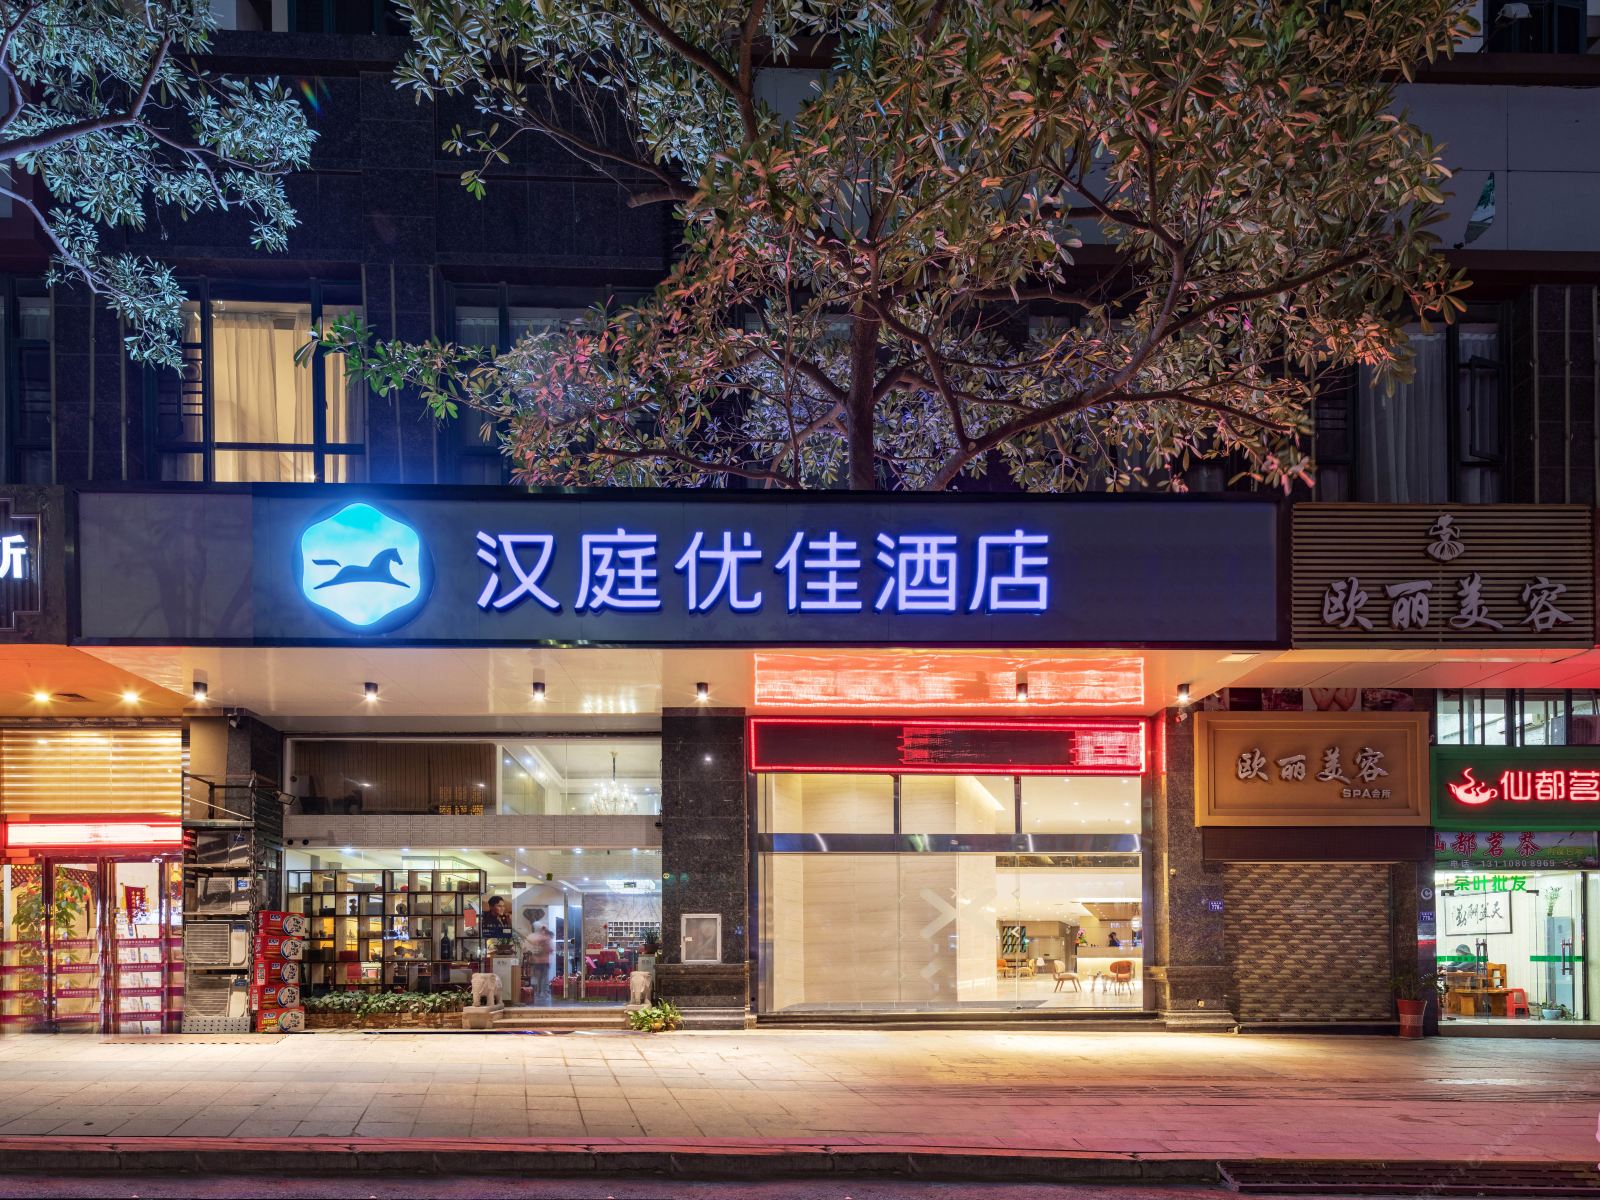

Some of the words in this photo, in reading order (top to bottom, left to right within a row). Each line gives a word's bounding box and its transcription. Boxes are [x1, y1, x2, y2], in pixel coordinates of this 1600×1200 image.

[476, 527, 1050, 611] 汉庭优佳酒店
[1322, 572, 1575, 632] 欧丽美容
[1237, 747, 1388, 784] 欧丽美容
[1454, 874, 1527, 892] 茶叶批发
